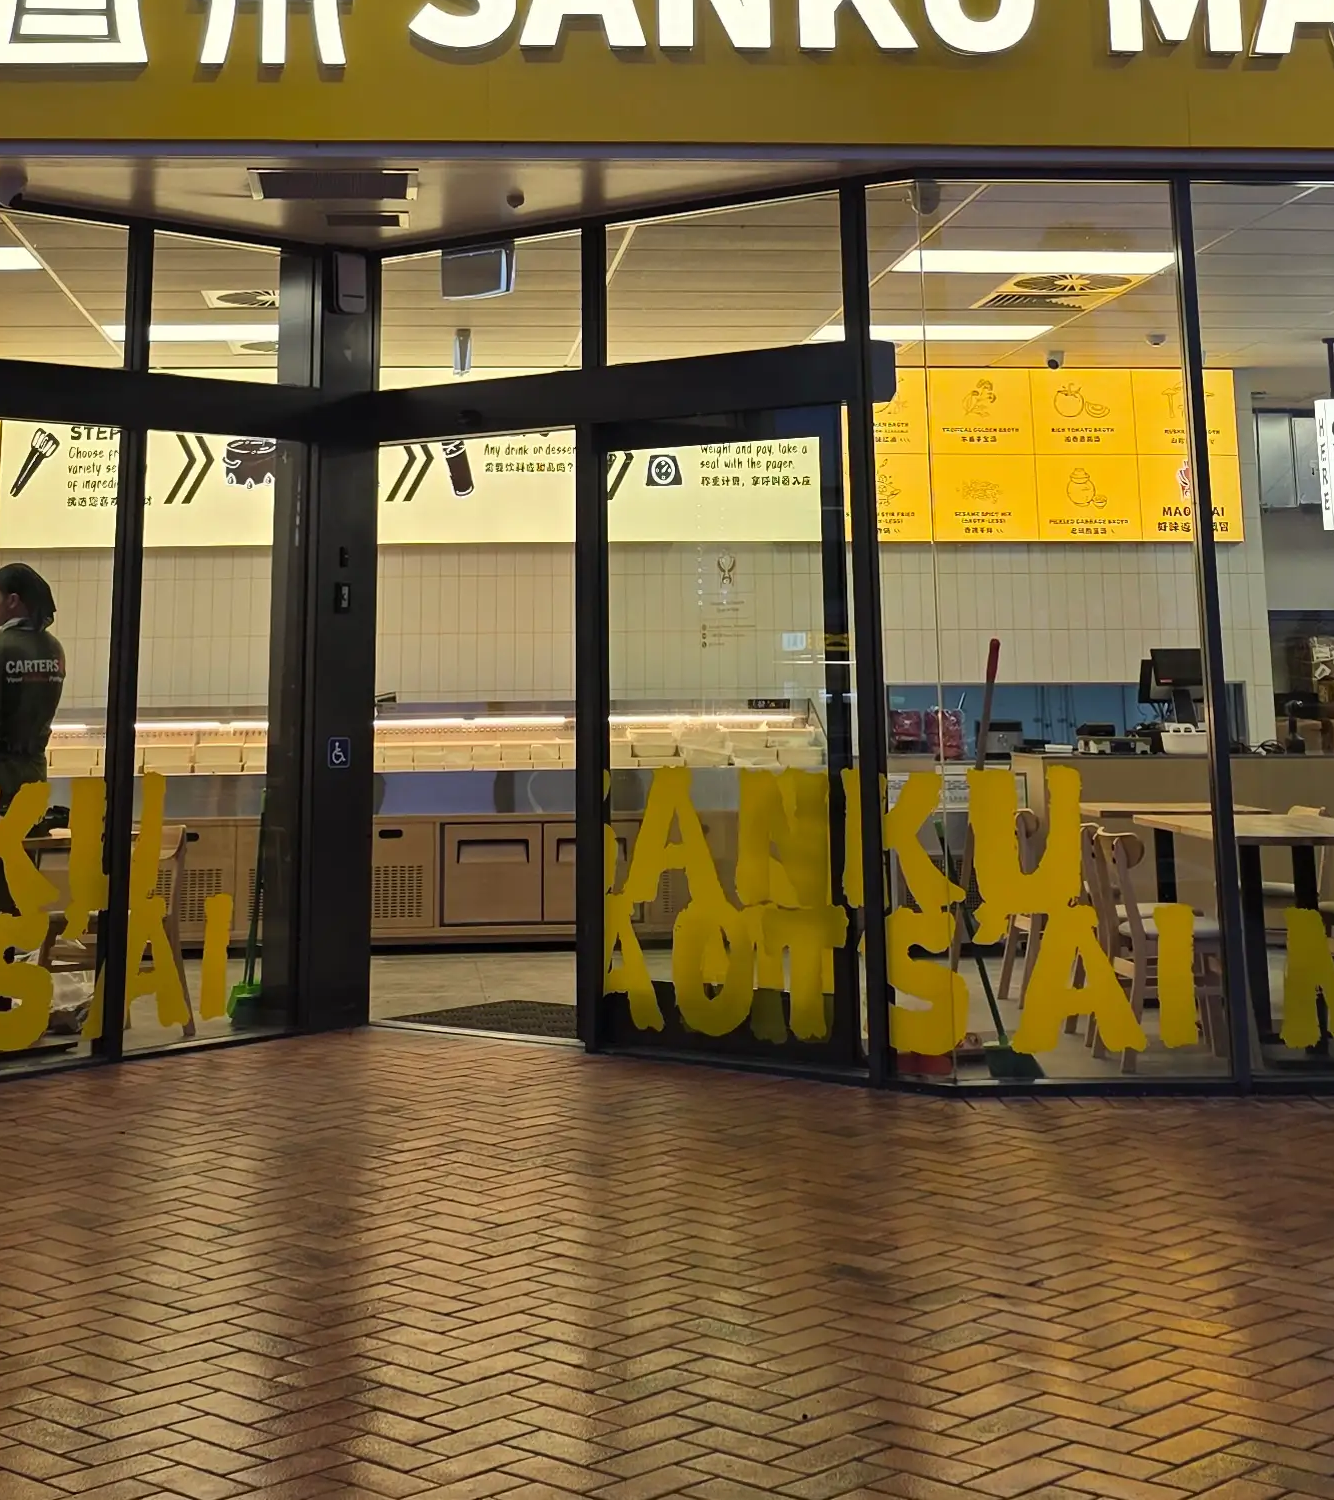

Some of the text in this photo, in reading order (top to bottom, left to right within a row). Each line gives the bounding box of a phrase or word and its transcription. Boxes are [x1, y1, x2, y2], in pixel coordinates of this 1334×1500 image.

[68, 446, 120, 461] Choose fr
[484, 442, 576, 457] Any drink or desser
[700, 444, 731, 457] Weight
[735, 443, 752, 454] and
[778, 443, 797, 455] take
[801, 446, 808, 455] a
[68, 462, 101, 476] variety
[700, 458, 719, 469] seat
[724, 458, 743, 469] with
[747, 458, 762, 469] the
[1318, 417, 1330, 511] HERE
[67, 477, 118, 492] of ingredi
[1162, 506, 1225, 517] MAOAI
[5, 659, 60, 674] CARTERS
[604, 764, 1082, 908] ANKU
